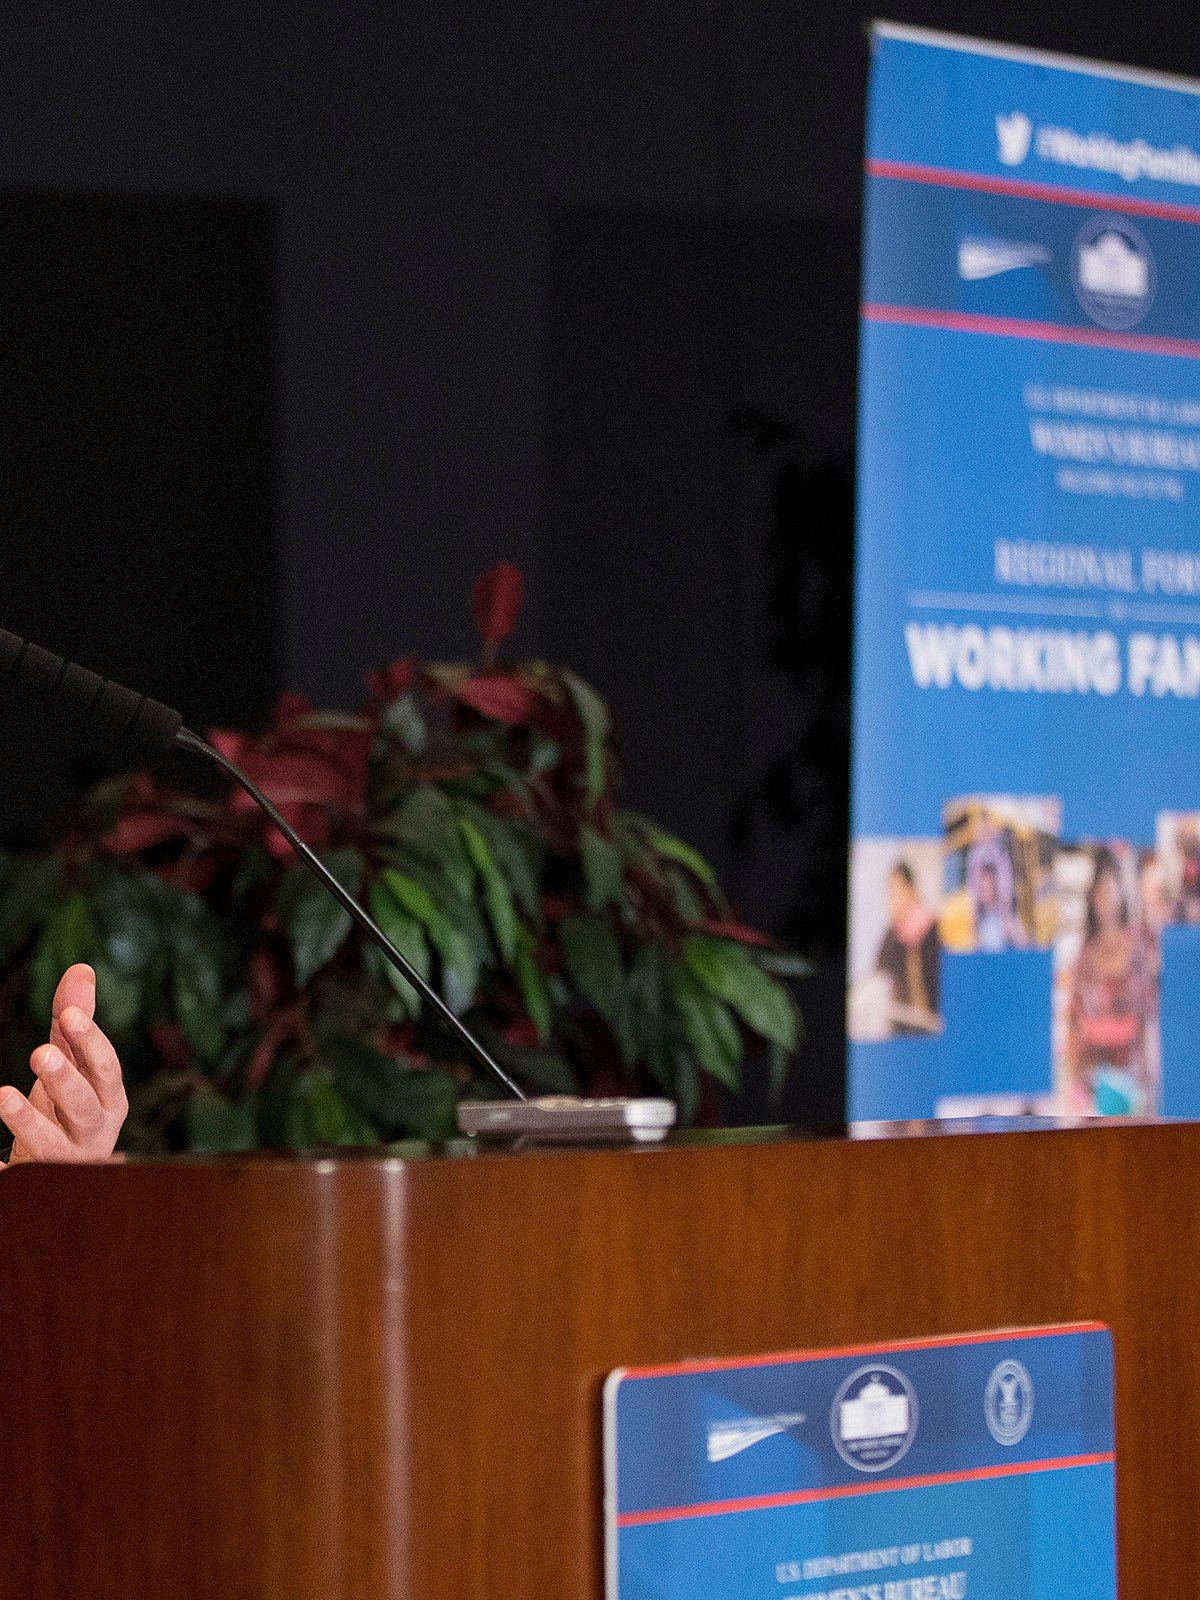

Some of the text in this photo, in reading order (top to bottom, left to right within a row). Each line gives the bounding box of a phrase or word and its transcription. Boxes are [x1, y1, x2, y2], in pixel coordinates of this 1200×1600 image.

[1141, 549, 1200, 595] FOR
[906, 623, 1121, 696] WORKING
[802, 1546, 900, 1579] DEPARTMENT
[901, 1543, 921, 1565] OF
[923, 1536, 972, 1561] LABOR
